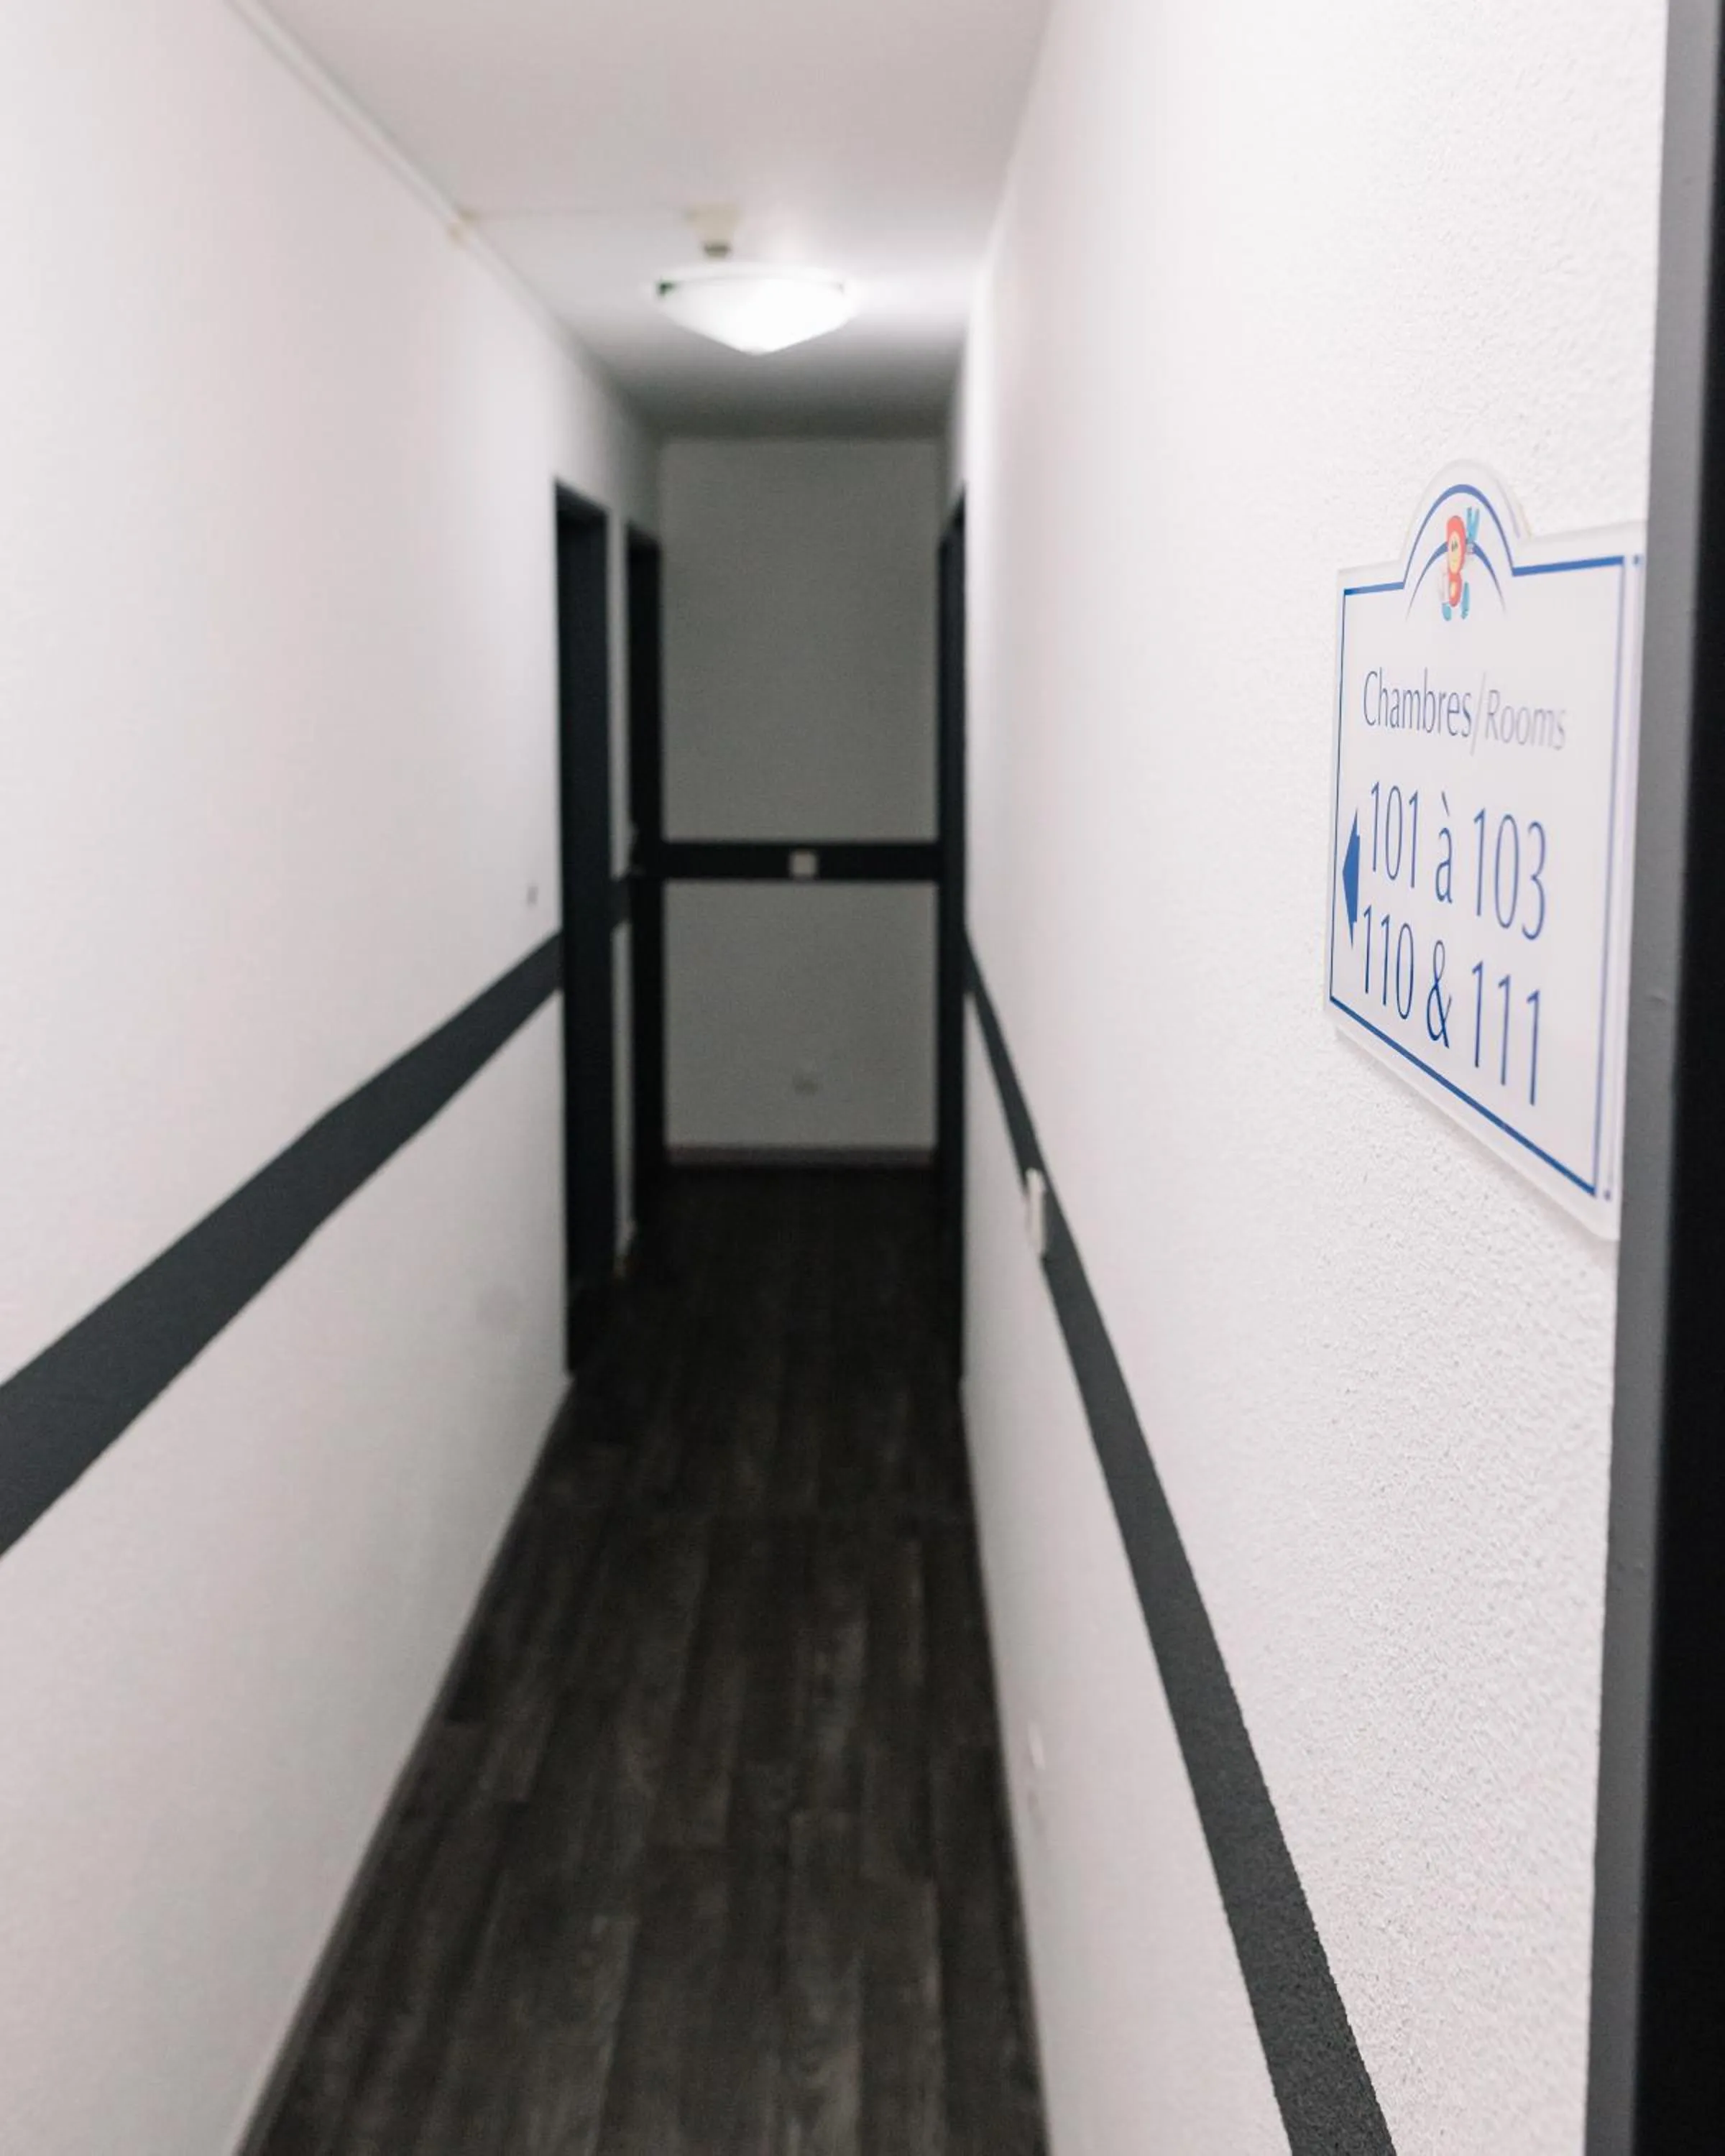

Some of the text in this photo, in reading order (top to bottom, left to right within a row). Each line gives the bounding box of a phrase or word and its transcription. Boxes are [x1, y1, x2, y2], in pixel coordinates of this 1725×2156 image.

[1363, 667, 1566, 756] Chambres/Rooms
[1371, 780, 1546, 940] 101 à 103
[1363, 904, 1540, 1106] 110 & 111
